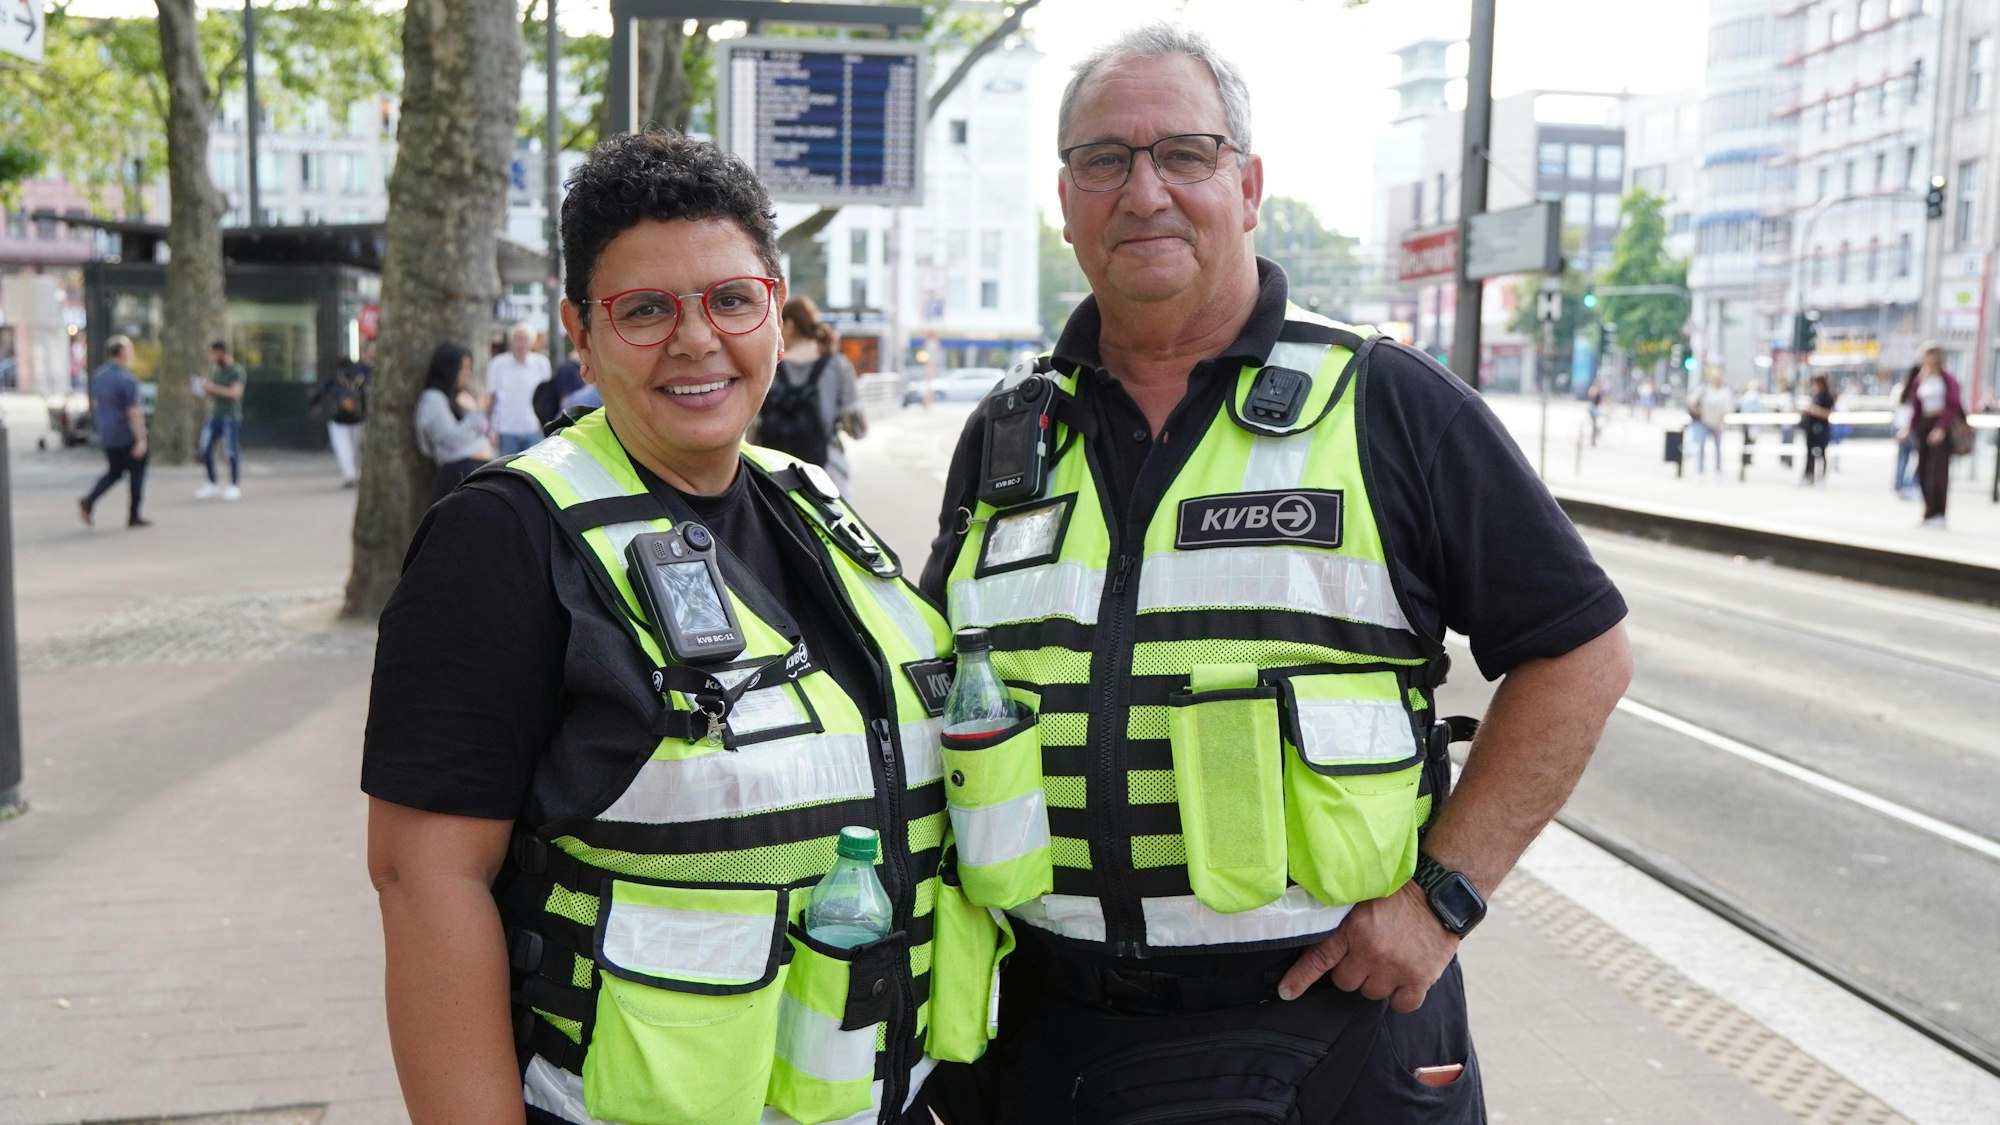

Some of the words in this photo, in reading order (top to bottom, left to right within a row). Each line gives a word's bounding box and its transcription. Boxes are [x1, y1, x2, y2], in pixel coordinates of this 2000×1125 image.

[995, 480, 1007, 489] KVB
[1201, 505, 1270, 531] KVB
[696, 635, 713, 644] KVB
[712, 633, 735, 642] BC-11
